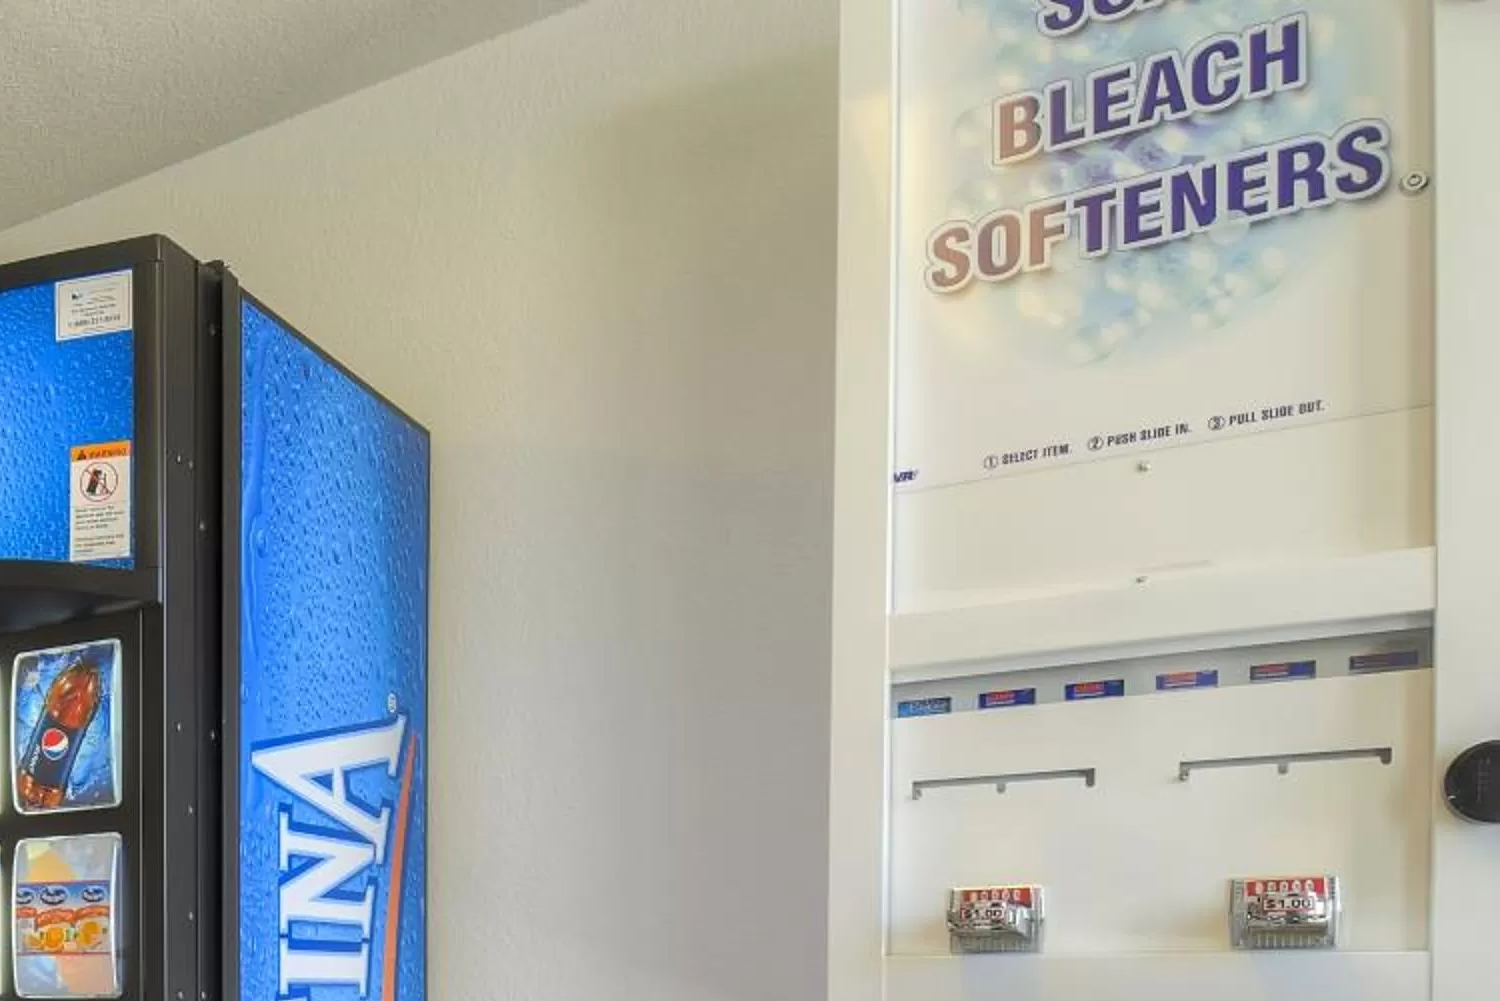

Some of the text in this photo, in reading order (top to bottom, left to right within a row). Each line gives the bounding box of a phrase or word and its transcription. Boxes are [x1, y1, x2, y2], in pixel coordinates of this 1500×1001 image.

[997, 16, 1303, 163] BLEACH
[929, 121, 1386, 291] SOFTENERS
[1106, 430, 1137, 447] PUSH
[1228, 411, 1257, 427] PULL
